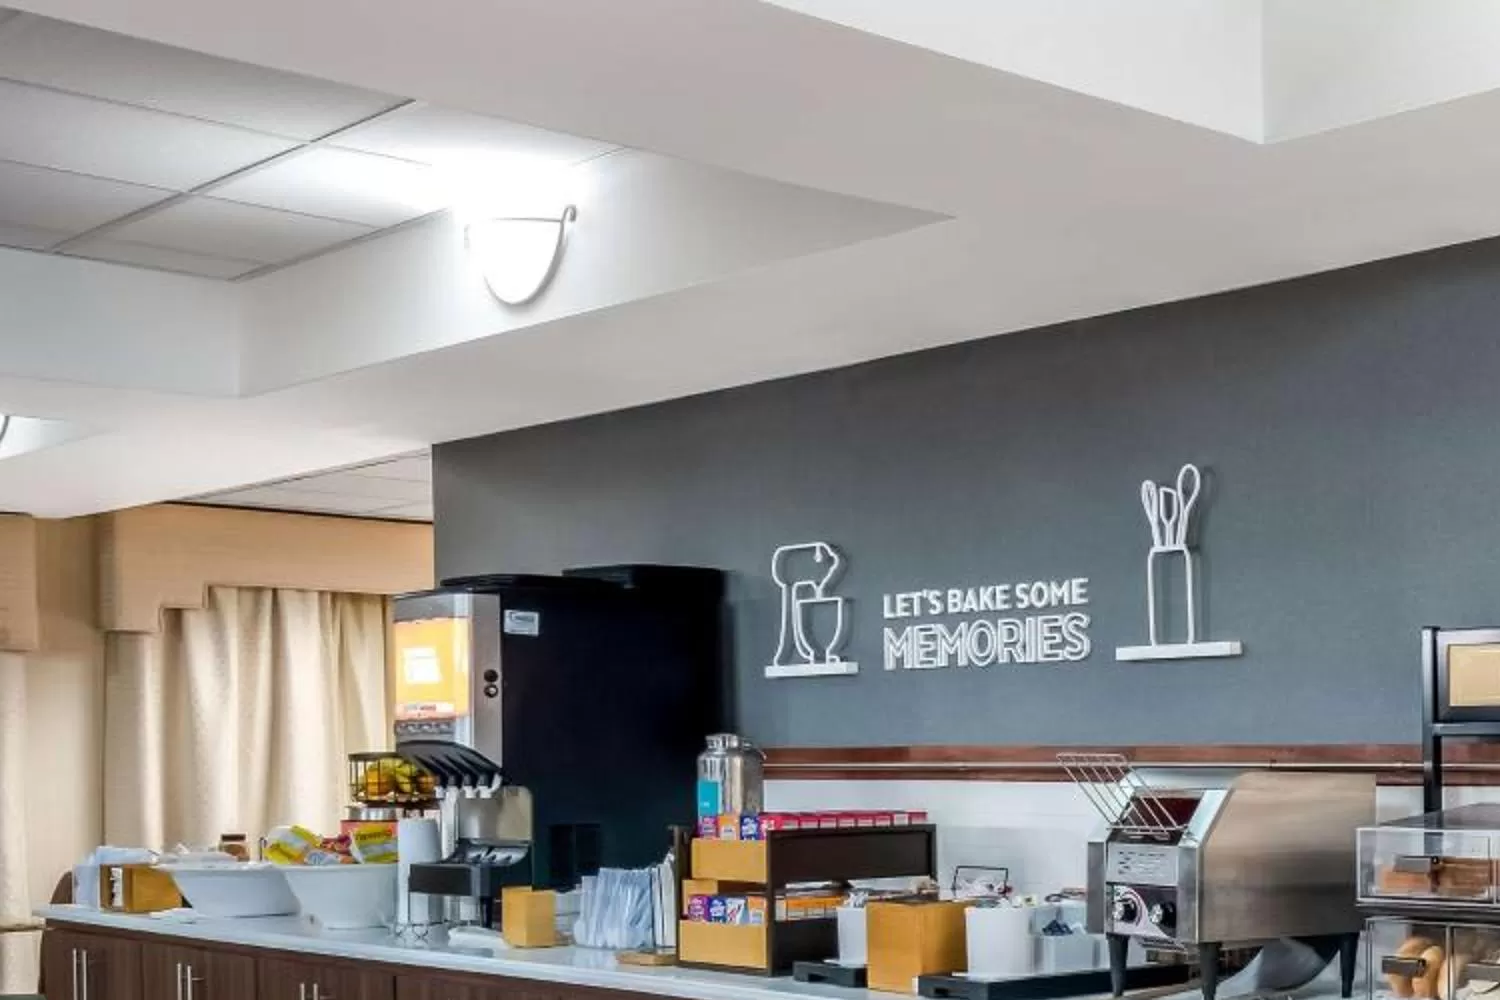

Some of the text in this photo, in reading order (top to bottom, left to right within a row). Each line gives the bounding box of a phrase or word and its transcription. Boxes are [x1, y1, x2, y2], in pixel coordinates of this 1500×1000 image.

[883, 577, 1089, 619] LET'S BAKE SOME
[883, 612, 1092, 671] MEMORIES
